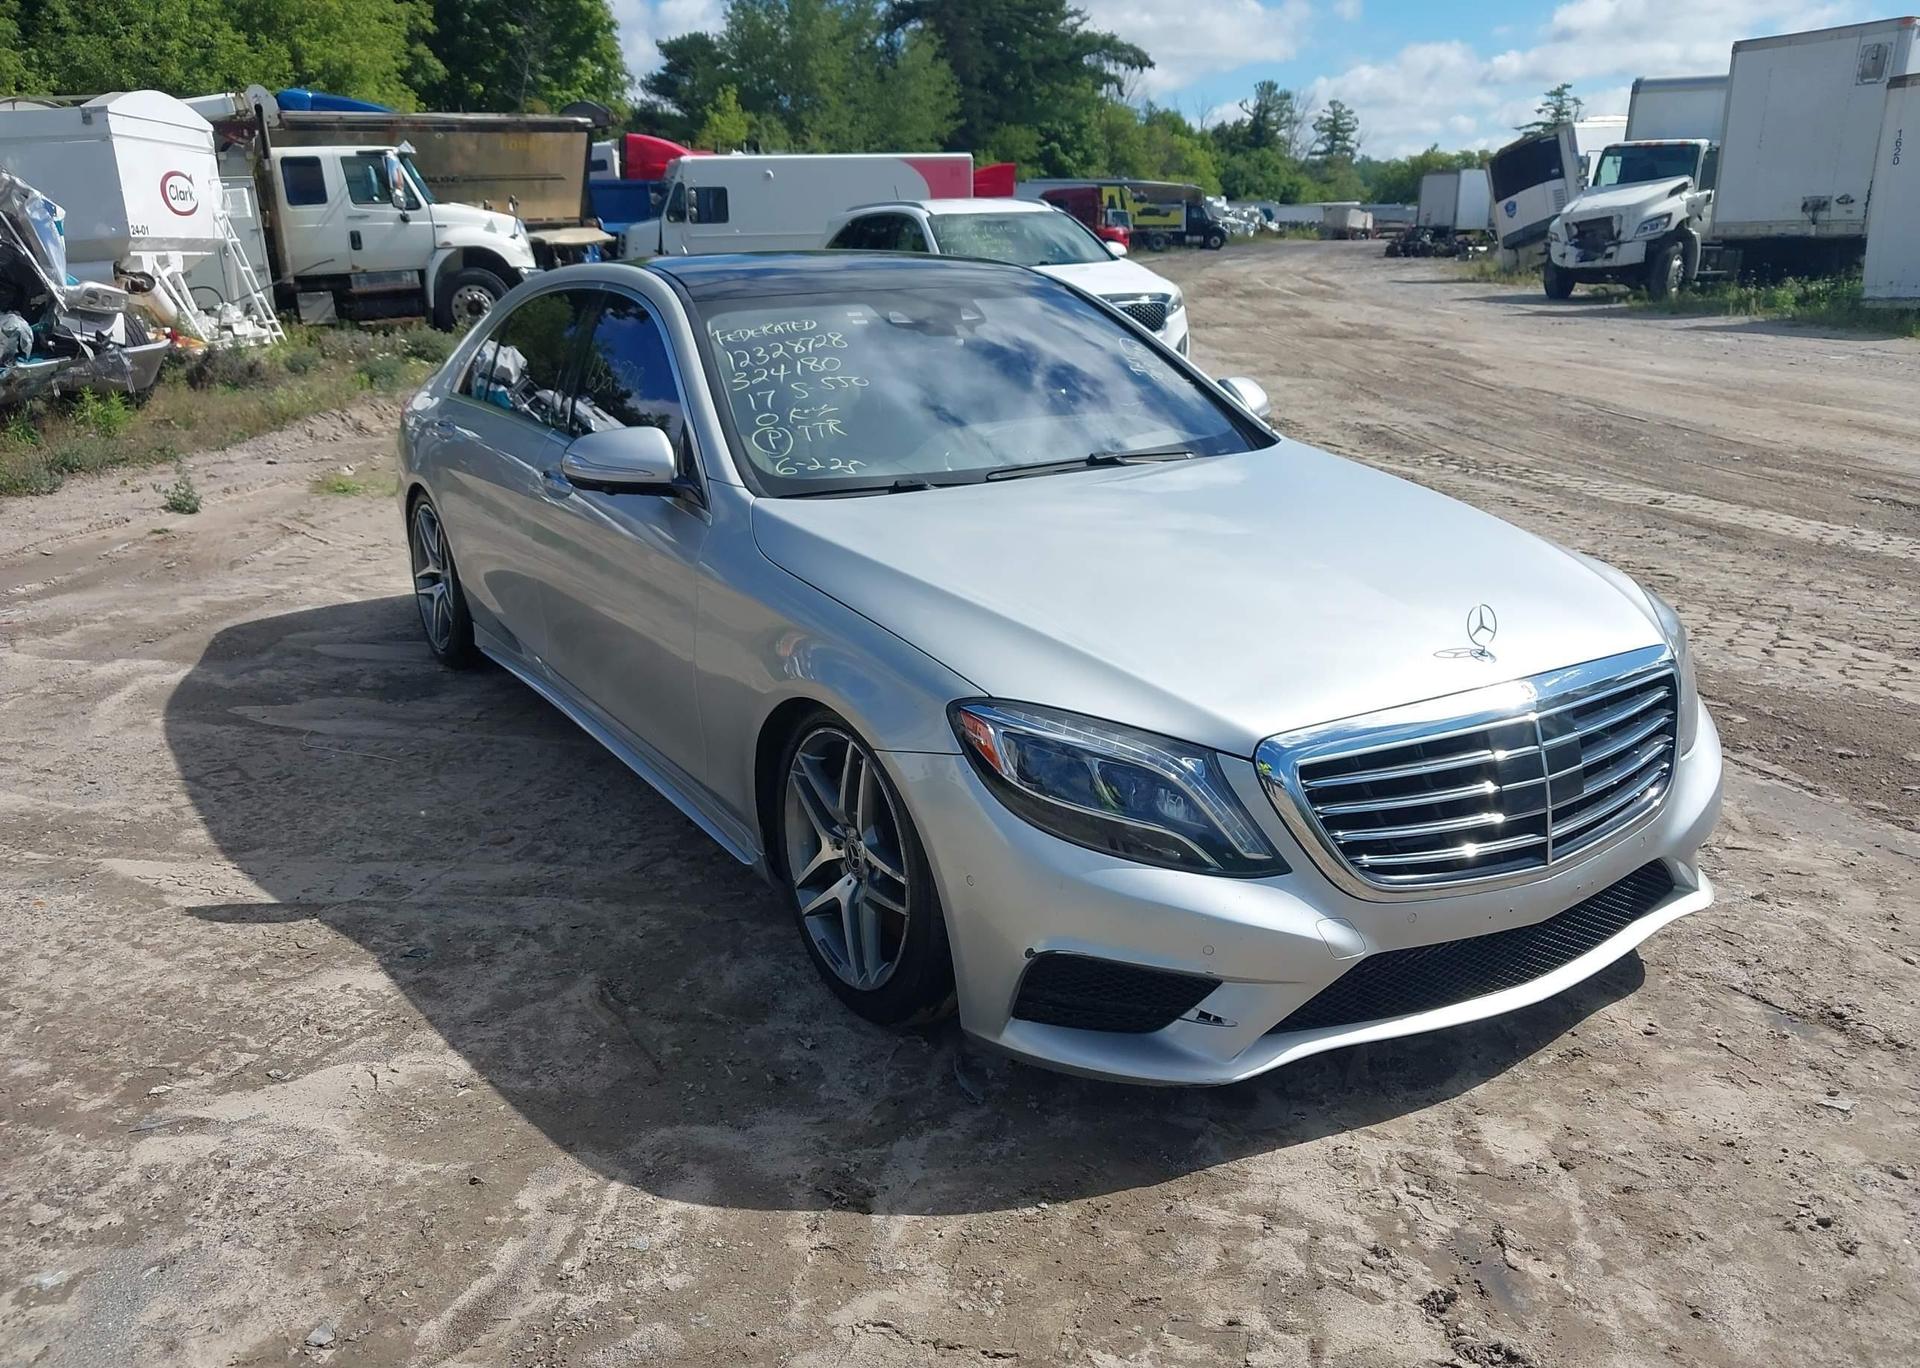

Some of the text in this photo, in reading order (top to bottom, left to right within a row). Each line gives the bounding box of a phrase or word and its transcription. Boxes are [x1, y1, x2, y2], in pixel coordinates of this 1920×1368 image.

[1893, 129, 1903, 165] 1620
[168, 184, 195, 201] Clark
[131, 225, 149, 235] 24-01
[712, 320, 817, 345] FEDERATED
